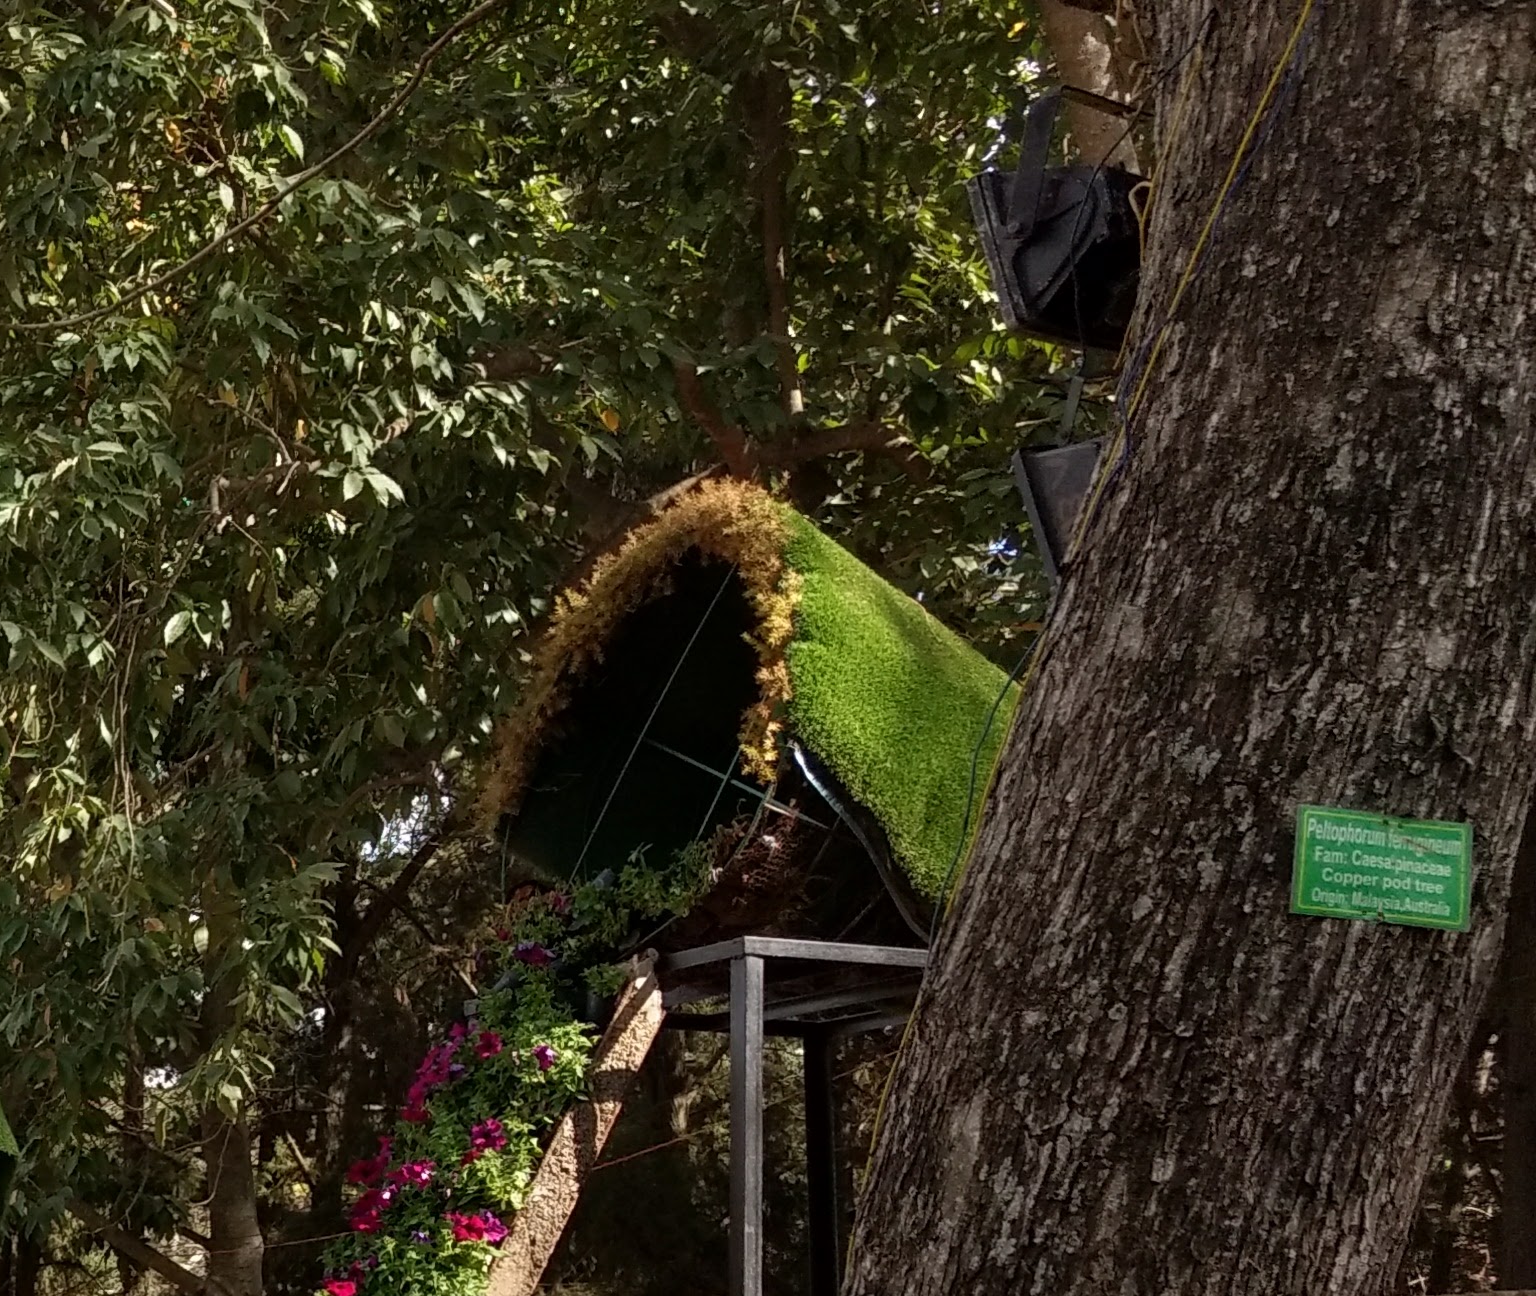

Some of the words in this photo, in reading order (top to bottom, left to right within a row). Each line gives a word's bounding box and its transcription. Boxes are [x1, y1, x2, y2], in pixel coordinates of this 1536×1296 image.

[1306, 817, 1386, 846] Peltophorum
[1314, 845, 1348, 864] Fam:
[1321, 867, 1380, 888] Copper
[1382, 876, 1411, 891] pod
[1414, 878, 1445, 895] tree
[1311, 887, 1348, 908] Origin:
